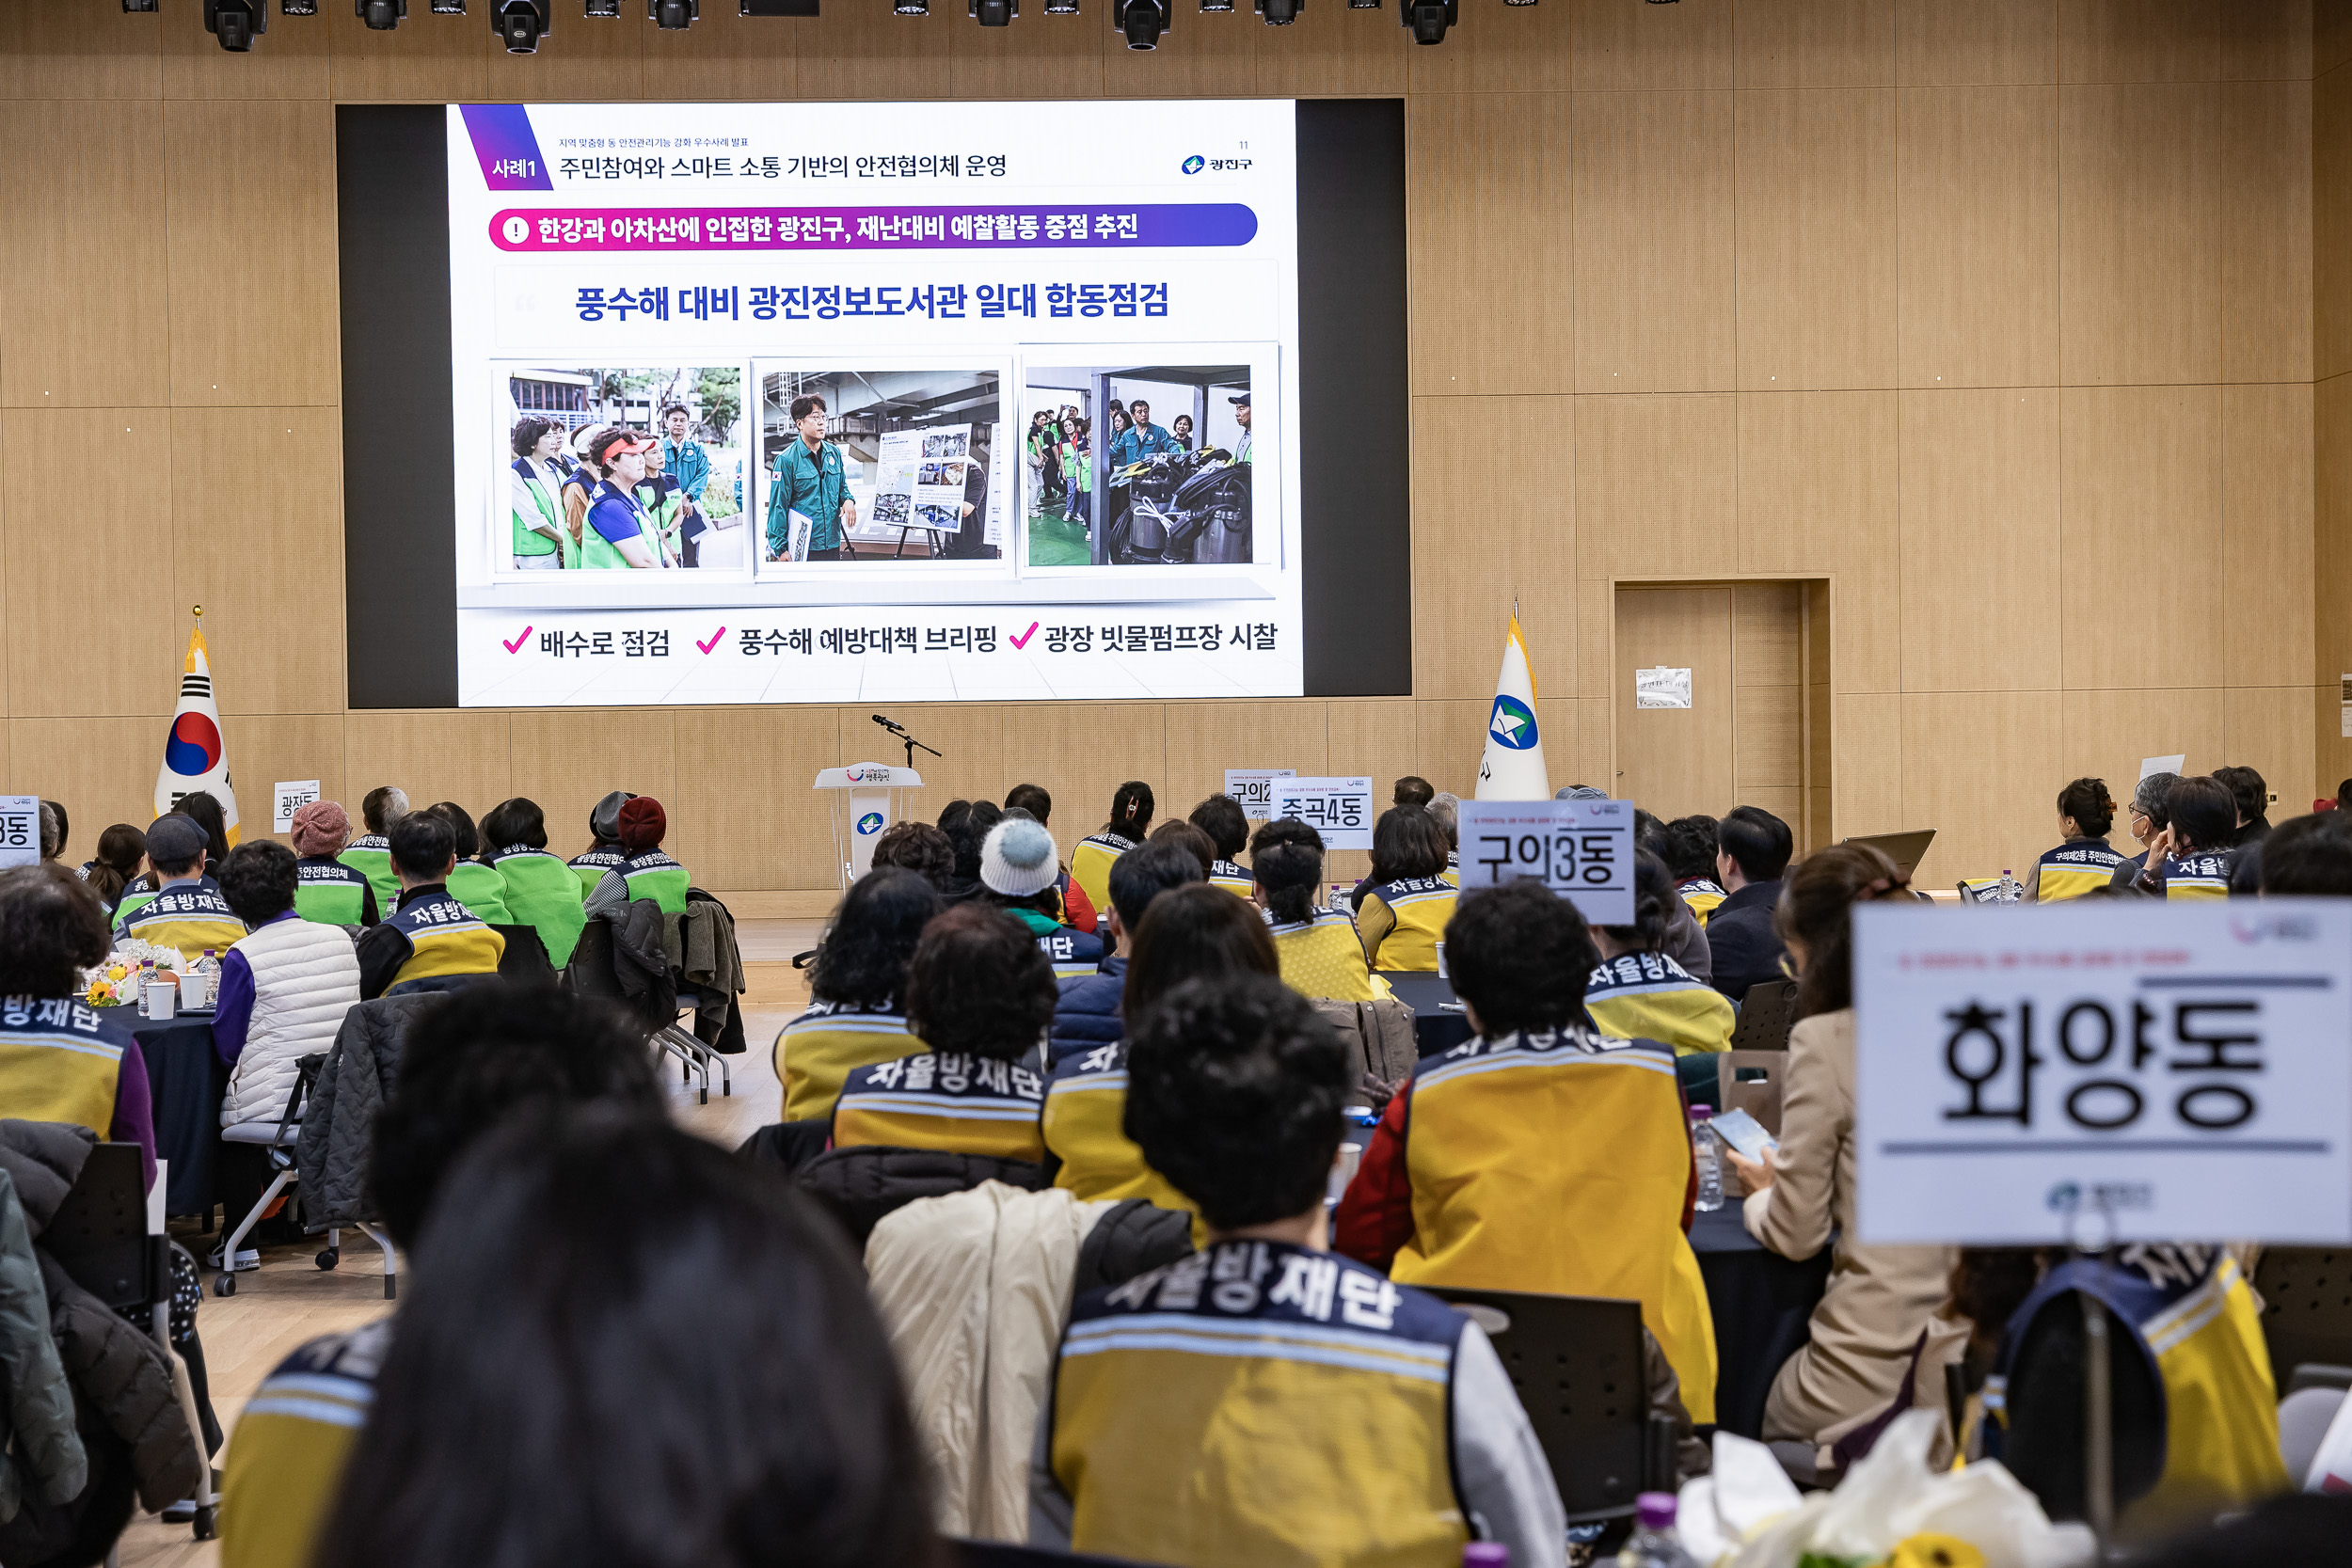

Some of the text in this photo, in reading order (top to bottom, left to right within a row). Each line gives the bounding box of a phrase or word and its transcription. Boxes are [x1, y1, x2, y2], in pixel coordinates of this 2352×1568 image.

[559, 137, 749, 148] 지역 맞춤형 동 안전관리기능 강화 우수사례 발표
[1239, 140, 1248, 150] 11
[492, 158, 536, 179] 사례1
[559, 154, 1007, 180] 주민참여와 스마트 소통 기반의 안전협의체 운영
[1210, 159, 1253, 171] 광진구
[537, 213, 1138, 244] 한강과 아차산에 인접한 광진구, 재난대비 예찰활동 중점 추진
[575, 282, 1168, 322] 풍수해 대비 광진정보도서관 일대 합동점검
[540, 629, 670, 658] 배수로 점검
[739, 626, 996, 656] 풍수해 예방대책 브리핑
[1044, 623, 1279, 653] 광장 빗물펌프장 시찰
[1281, 798, 1362, 827] 중곡4동
[1478, 834, 1614, 884] 구의3동
[141, 893, 230, 915] 자율방재단
[866, 1051, 1045, 1101] 자율방재단
[1941, 997, 2265, 1132] 화양동
[1104, 1242, 1404, 1330] 자율방재단
